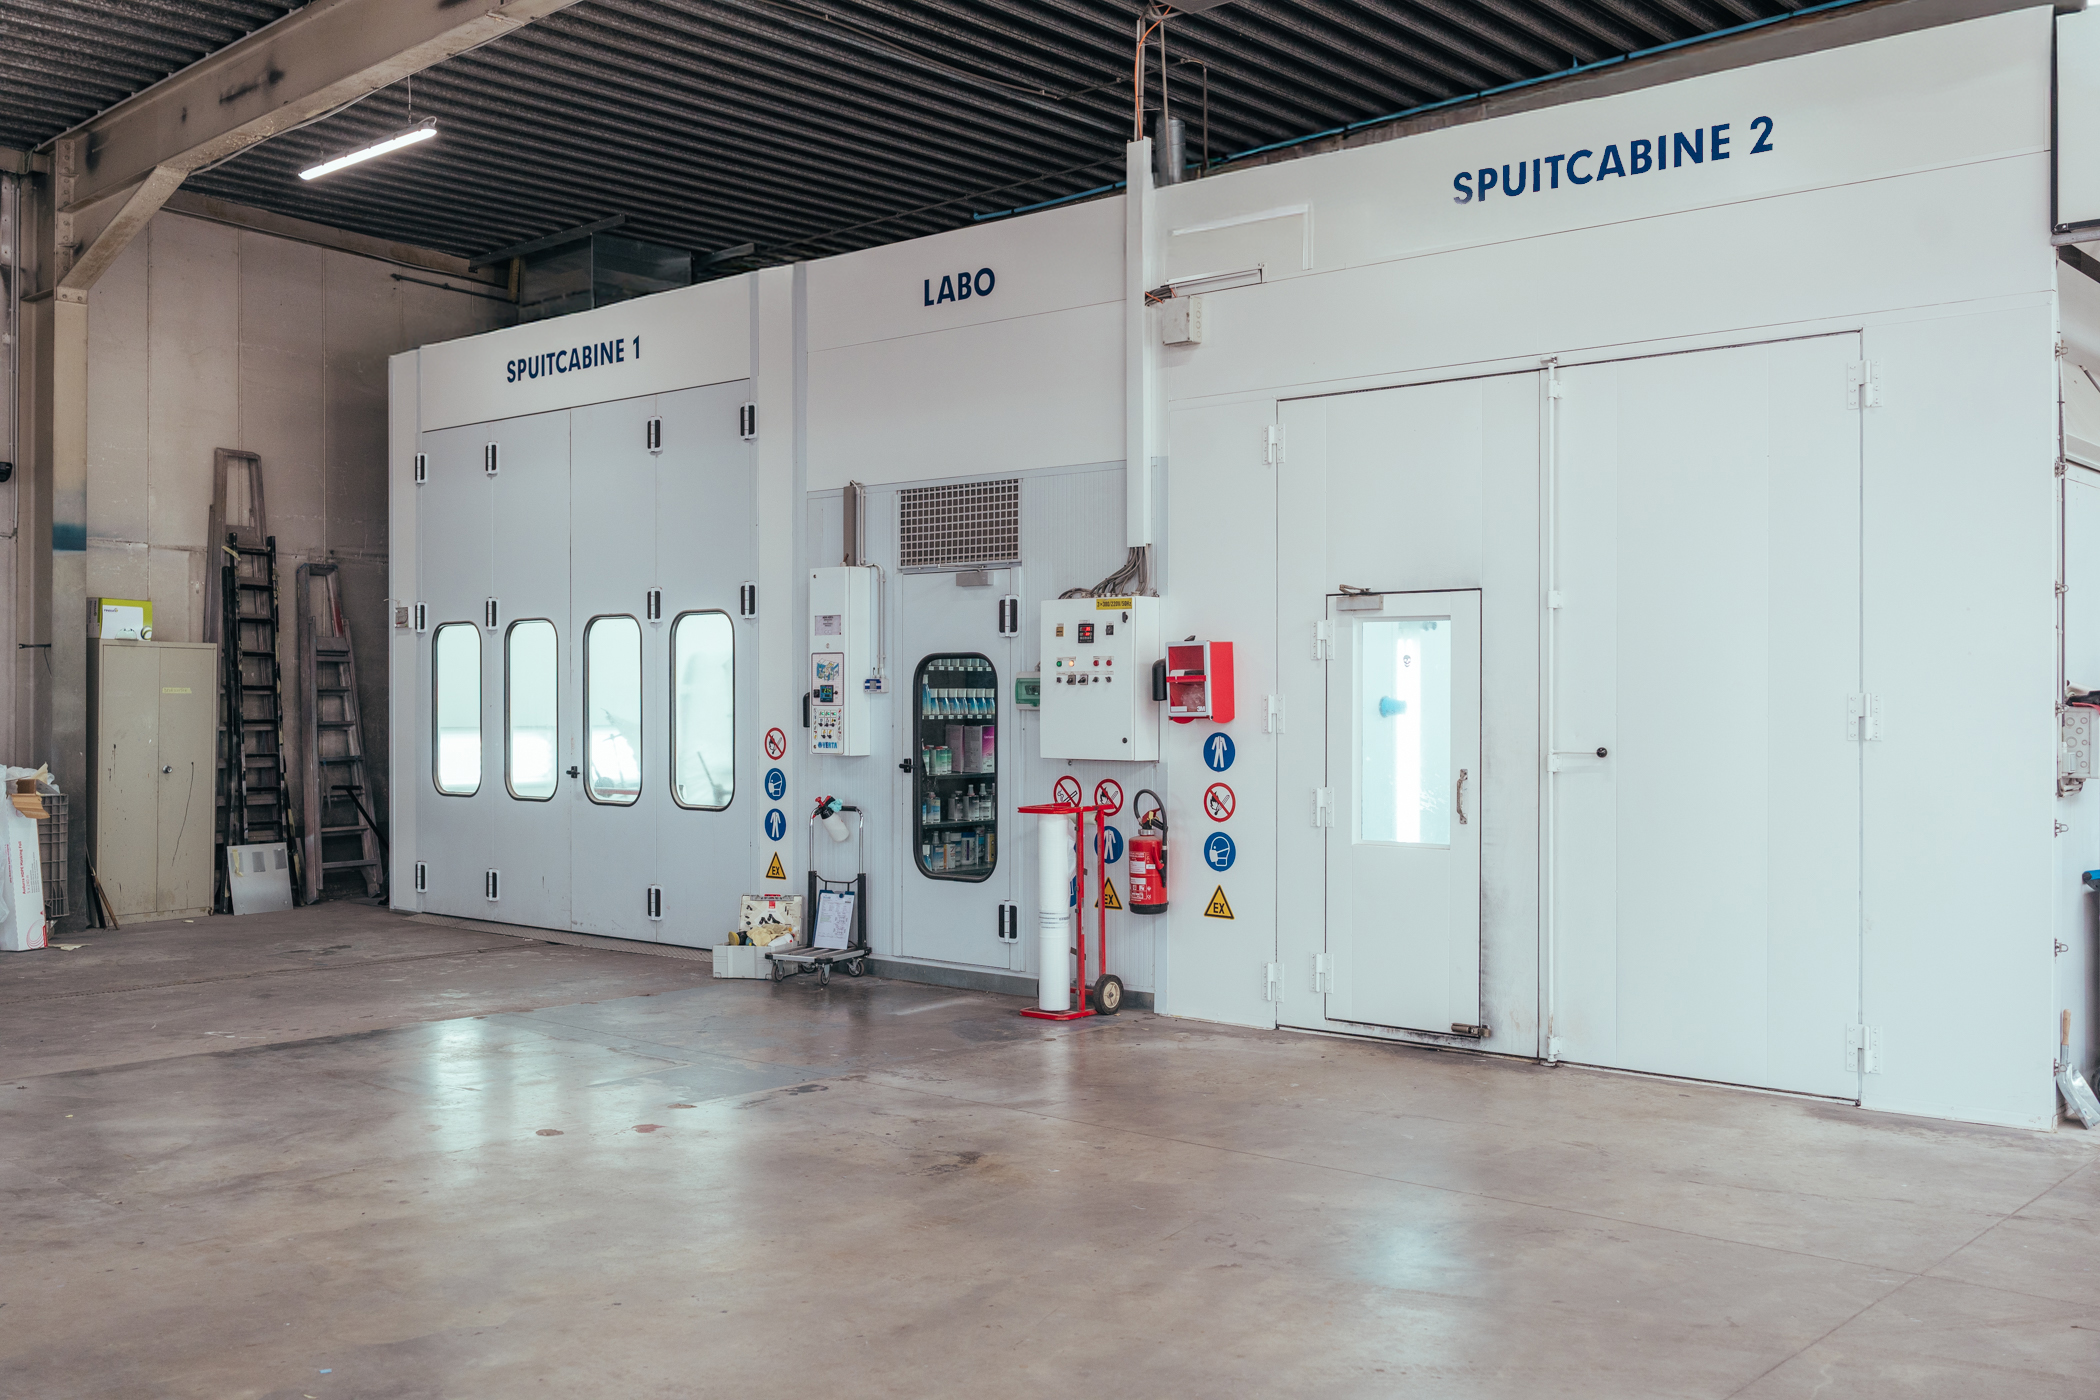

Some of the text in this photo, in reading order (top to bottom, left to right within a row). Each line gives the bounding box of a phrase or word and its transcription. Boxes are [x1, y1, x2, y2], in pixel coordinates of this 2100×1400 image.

[1453, 116, 1774, 205] SPUITCABINE 2
[924, 267, 996, 307] LABO
[507, 335, 640, 383] SPUITCABINE 1
[771, 866, 780, 876] EX
[1105, 894, 1114, 905] EX
[1213, 902, 1225, 915] EX
